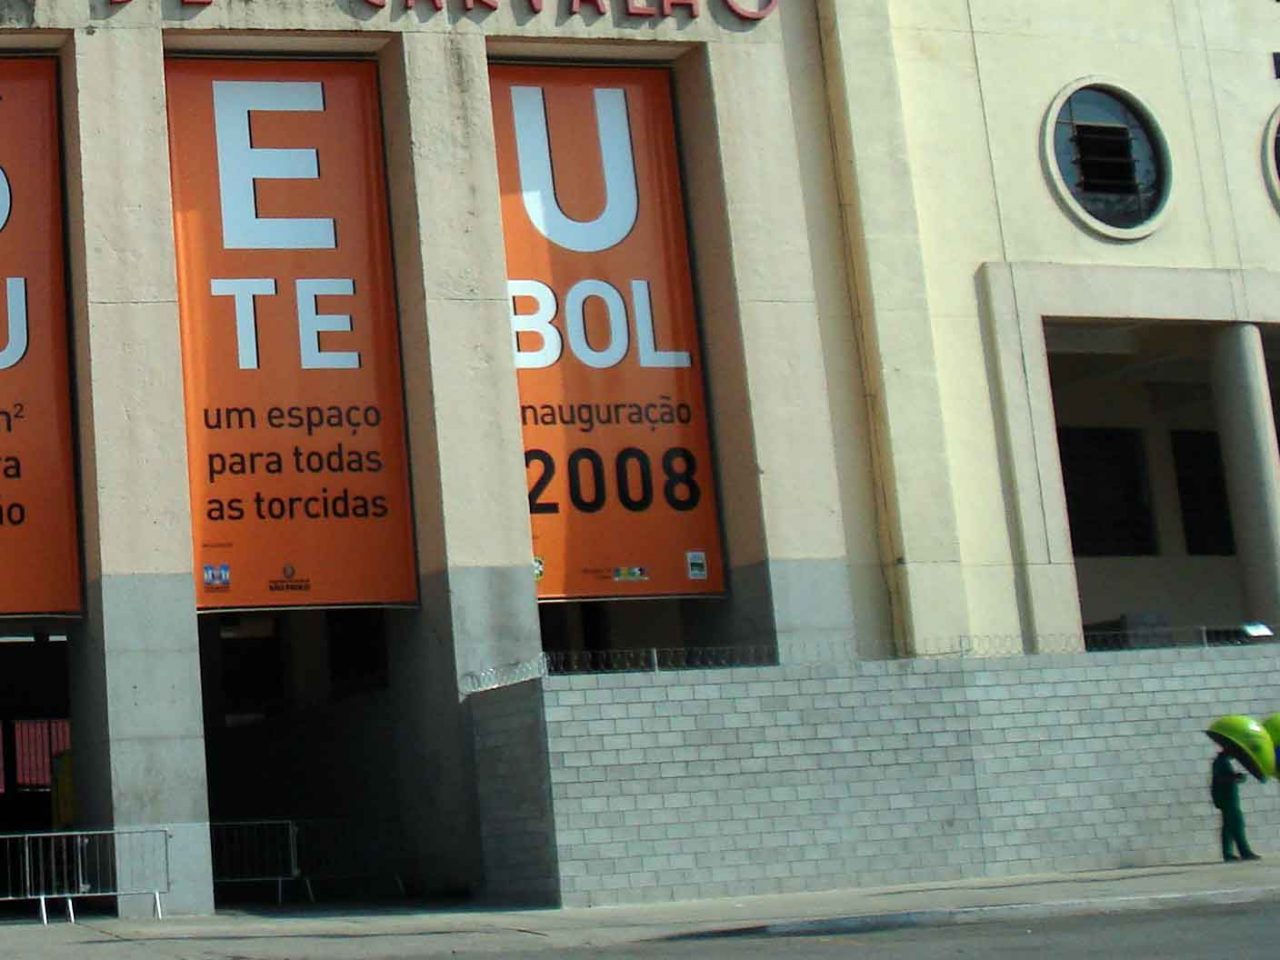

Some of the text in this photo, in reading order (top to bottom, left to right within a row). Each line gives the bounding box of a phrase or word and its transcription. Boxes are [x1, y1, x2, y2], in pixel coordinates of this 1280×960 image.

[211, 80, 338, 249] E
[510, 85, 640, 253] U
[210, 278, 361, 370] TE
[507, 278, 693, 370] BOL
[204, 404, 382, 436] um espaço
[208, 443, 384, 484] para todas
[524, 447, 702, 514] 2008
[206, 487, 389, 521] as torcidas
